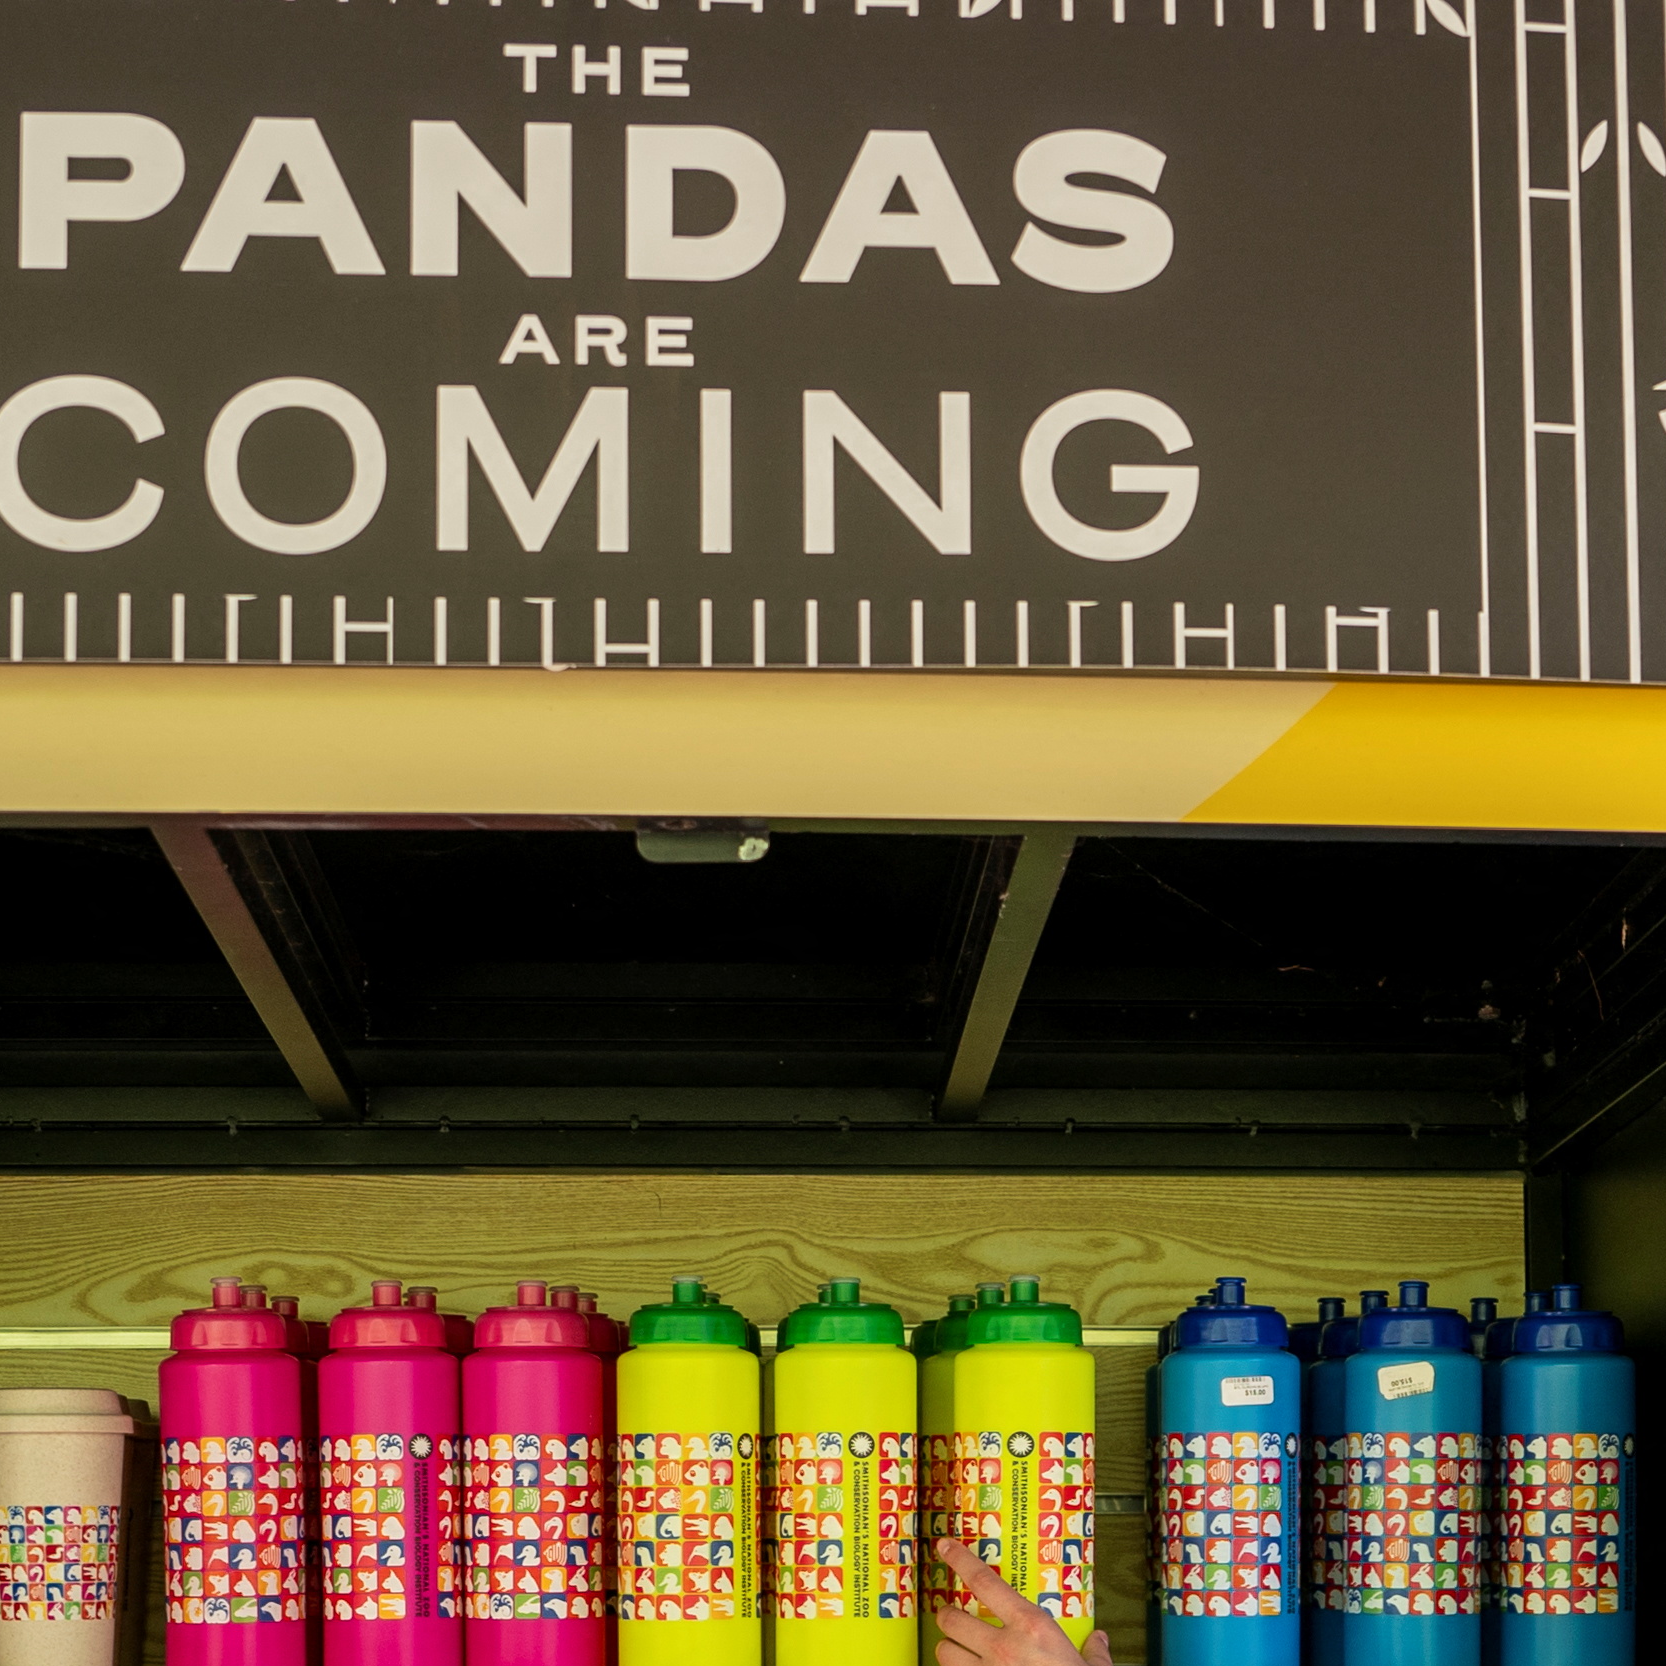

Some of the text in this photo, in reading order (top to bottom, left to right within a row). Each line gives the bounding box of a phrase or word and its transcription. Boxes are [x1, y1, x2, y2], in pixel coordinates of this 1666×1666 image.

[503, 43, 690, 97] THE
[18, 111, 1175, 295] PANDAS
[499, 313, 696, 368] ARE
[1391, 1377, 1413, 1387] $15.00
[413, 1470, 422, 1533] CONSERVATION
[853, 1469, 861, 1533] CONSERVATION
[1011, 1468, 1019, 1533] CONSERVATION
[1020, 1461, 1028, 1538] SMITHSONIAN'S
[414, 1537, 422, 1572] BIOLOGY
[422, 1544, 430, 1592] NATIONAL
[853, 1536, 861, 1572] BIOLOGY
[1011, 1535, 1019, 1571] BIOLOGY
[1020, 1543, 1028, 1592] NATIONAL
[853, 1574, 861, 1618] INSTITUTE
